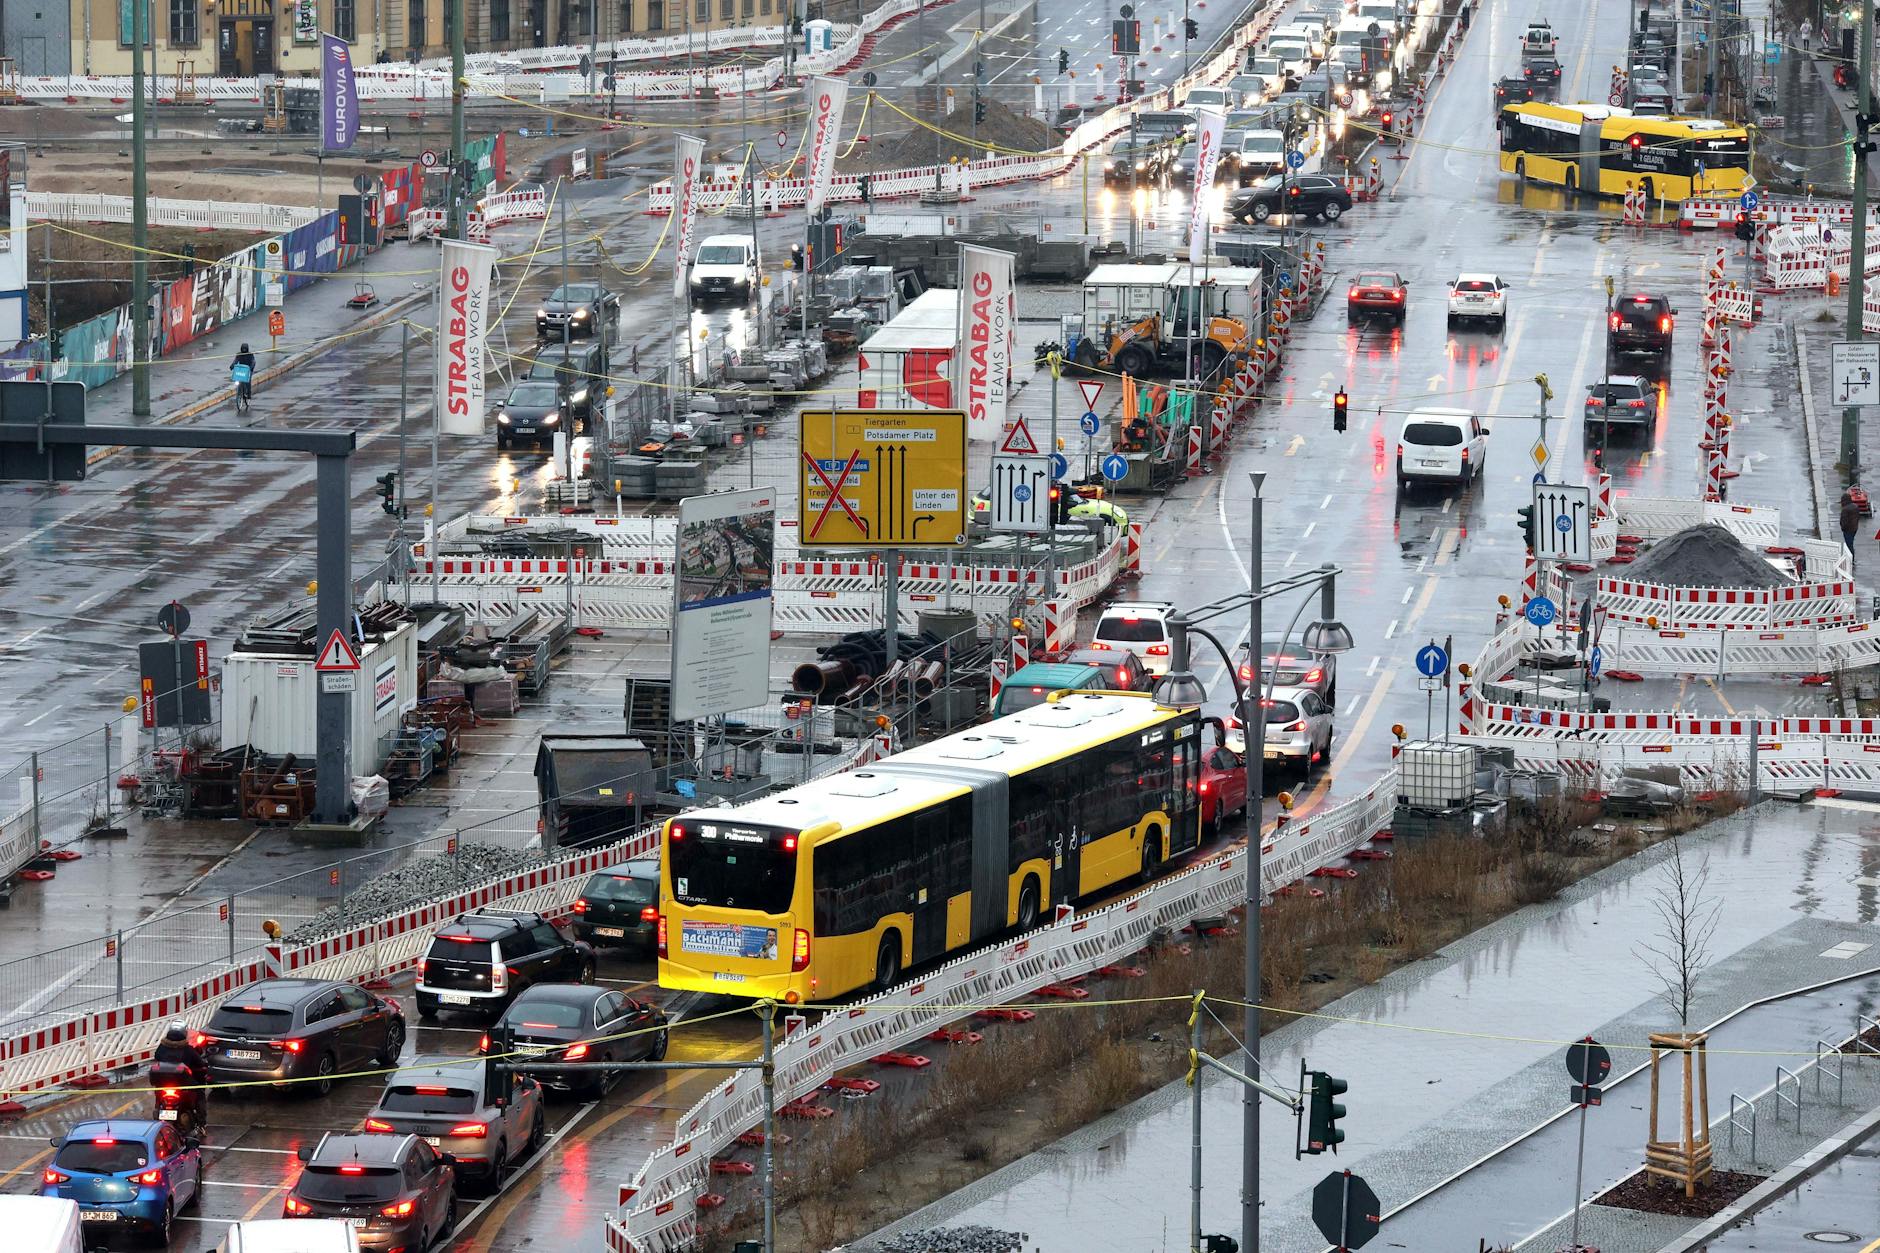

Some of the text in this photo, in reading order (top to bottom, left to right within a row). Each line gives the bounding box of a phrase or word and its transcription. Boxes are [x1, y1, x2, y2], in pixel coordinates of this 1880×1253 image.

[336, 67, 347, 143] EUROVIA
[681, 223, 693, 267] TEAMS
[448, 266, 469, 416] STRABAG
[470, 285, 482, 400] TEAMS WORK.
[970, 271, 992, 421] STRABAG
[991, 290, 1005, 406] TEAMS WORK.
[864, 418, 906, 427] Tiergarten
[866, 431, 934, 440] Potsdamer Platz
[915, 491, 956, 499] Unter den
[376, 674, 396, 702] STRABAG
[701, 825, 717, 839] 300
[725, 832, 764, 843] Philharmonie
[678, 895, 708, 903] CITARO
[683, 932, 741, 947] BACHMANN
[683, 941, 740, 953] Immobilien
